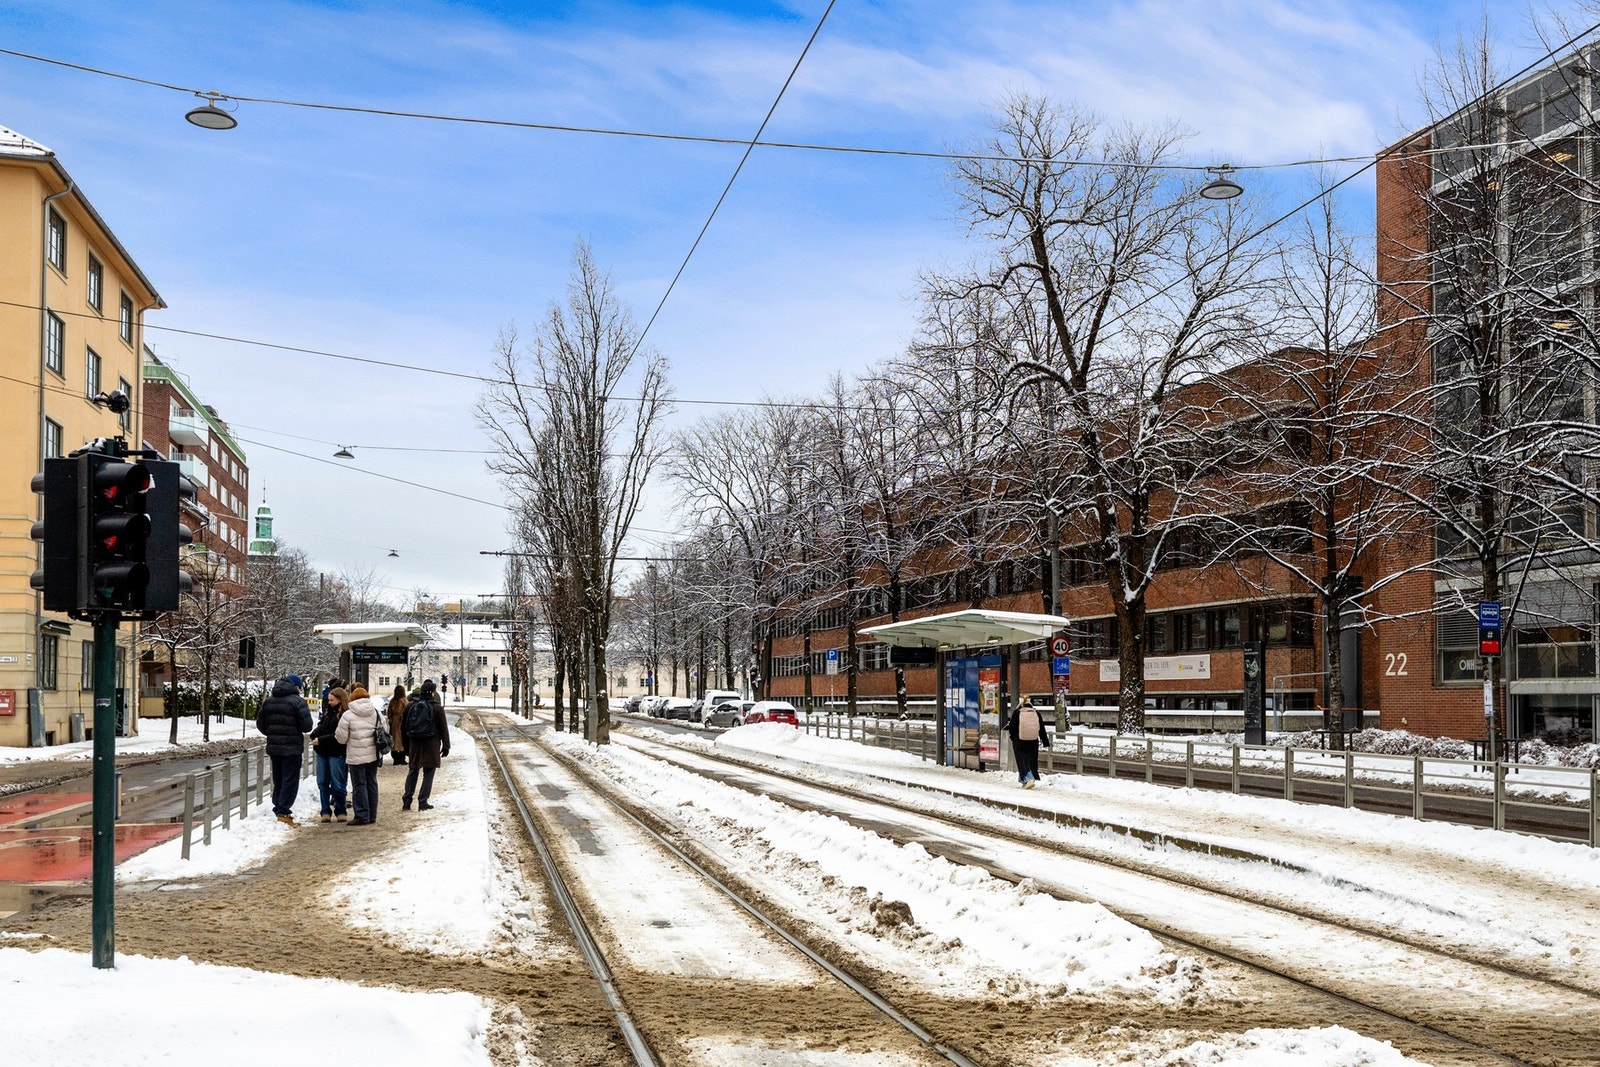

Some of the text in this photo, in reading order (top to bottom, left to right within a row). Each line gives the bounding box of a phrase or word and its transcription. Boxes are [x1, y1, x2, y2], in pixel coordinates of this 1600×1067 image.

[1055, 641, 1067, 652] 40
[829, 650, 835, 659] P
[1385, 652, 1408, 676] 22
